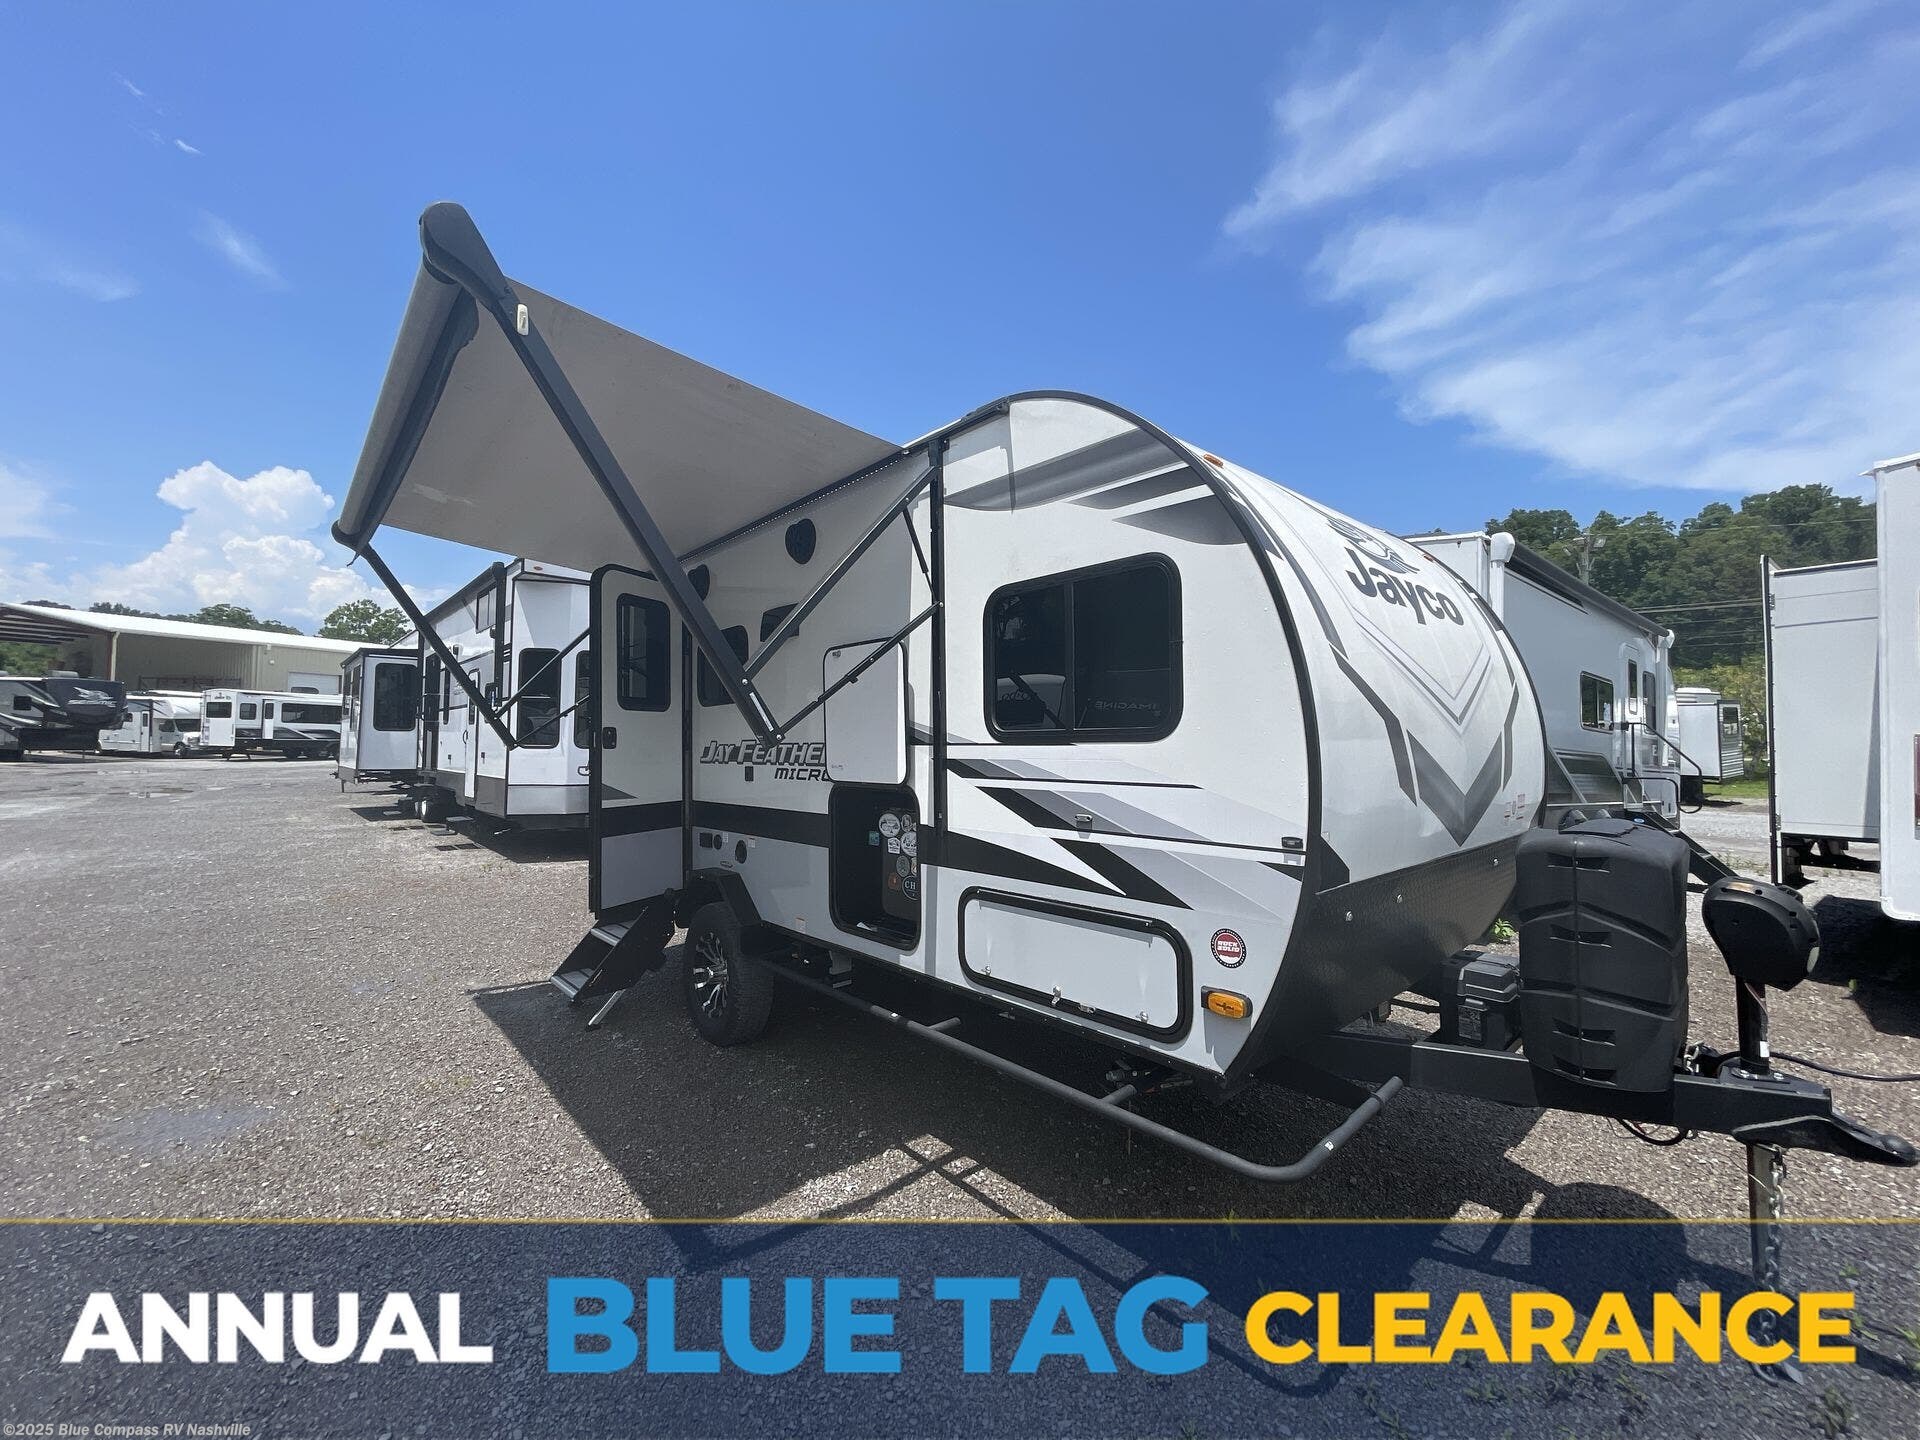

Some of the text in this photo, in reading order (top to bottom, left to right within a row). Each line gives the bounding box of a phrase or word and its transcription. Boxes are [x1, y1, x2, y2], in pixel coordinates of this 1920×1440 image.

[1344, 547, 1464, 626] Jayco
[700, 739, 826, 766] JAY FEATHE
